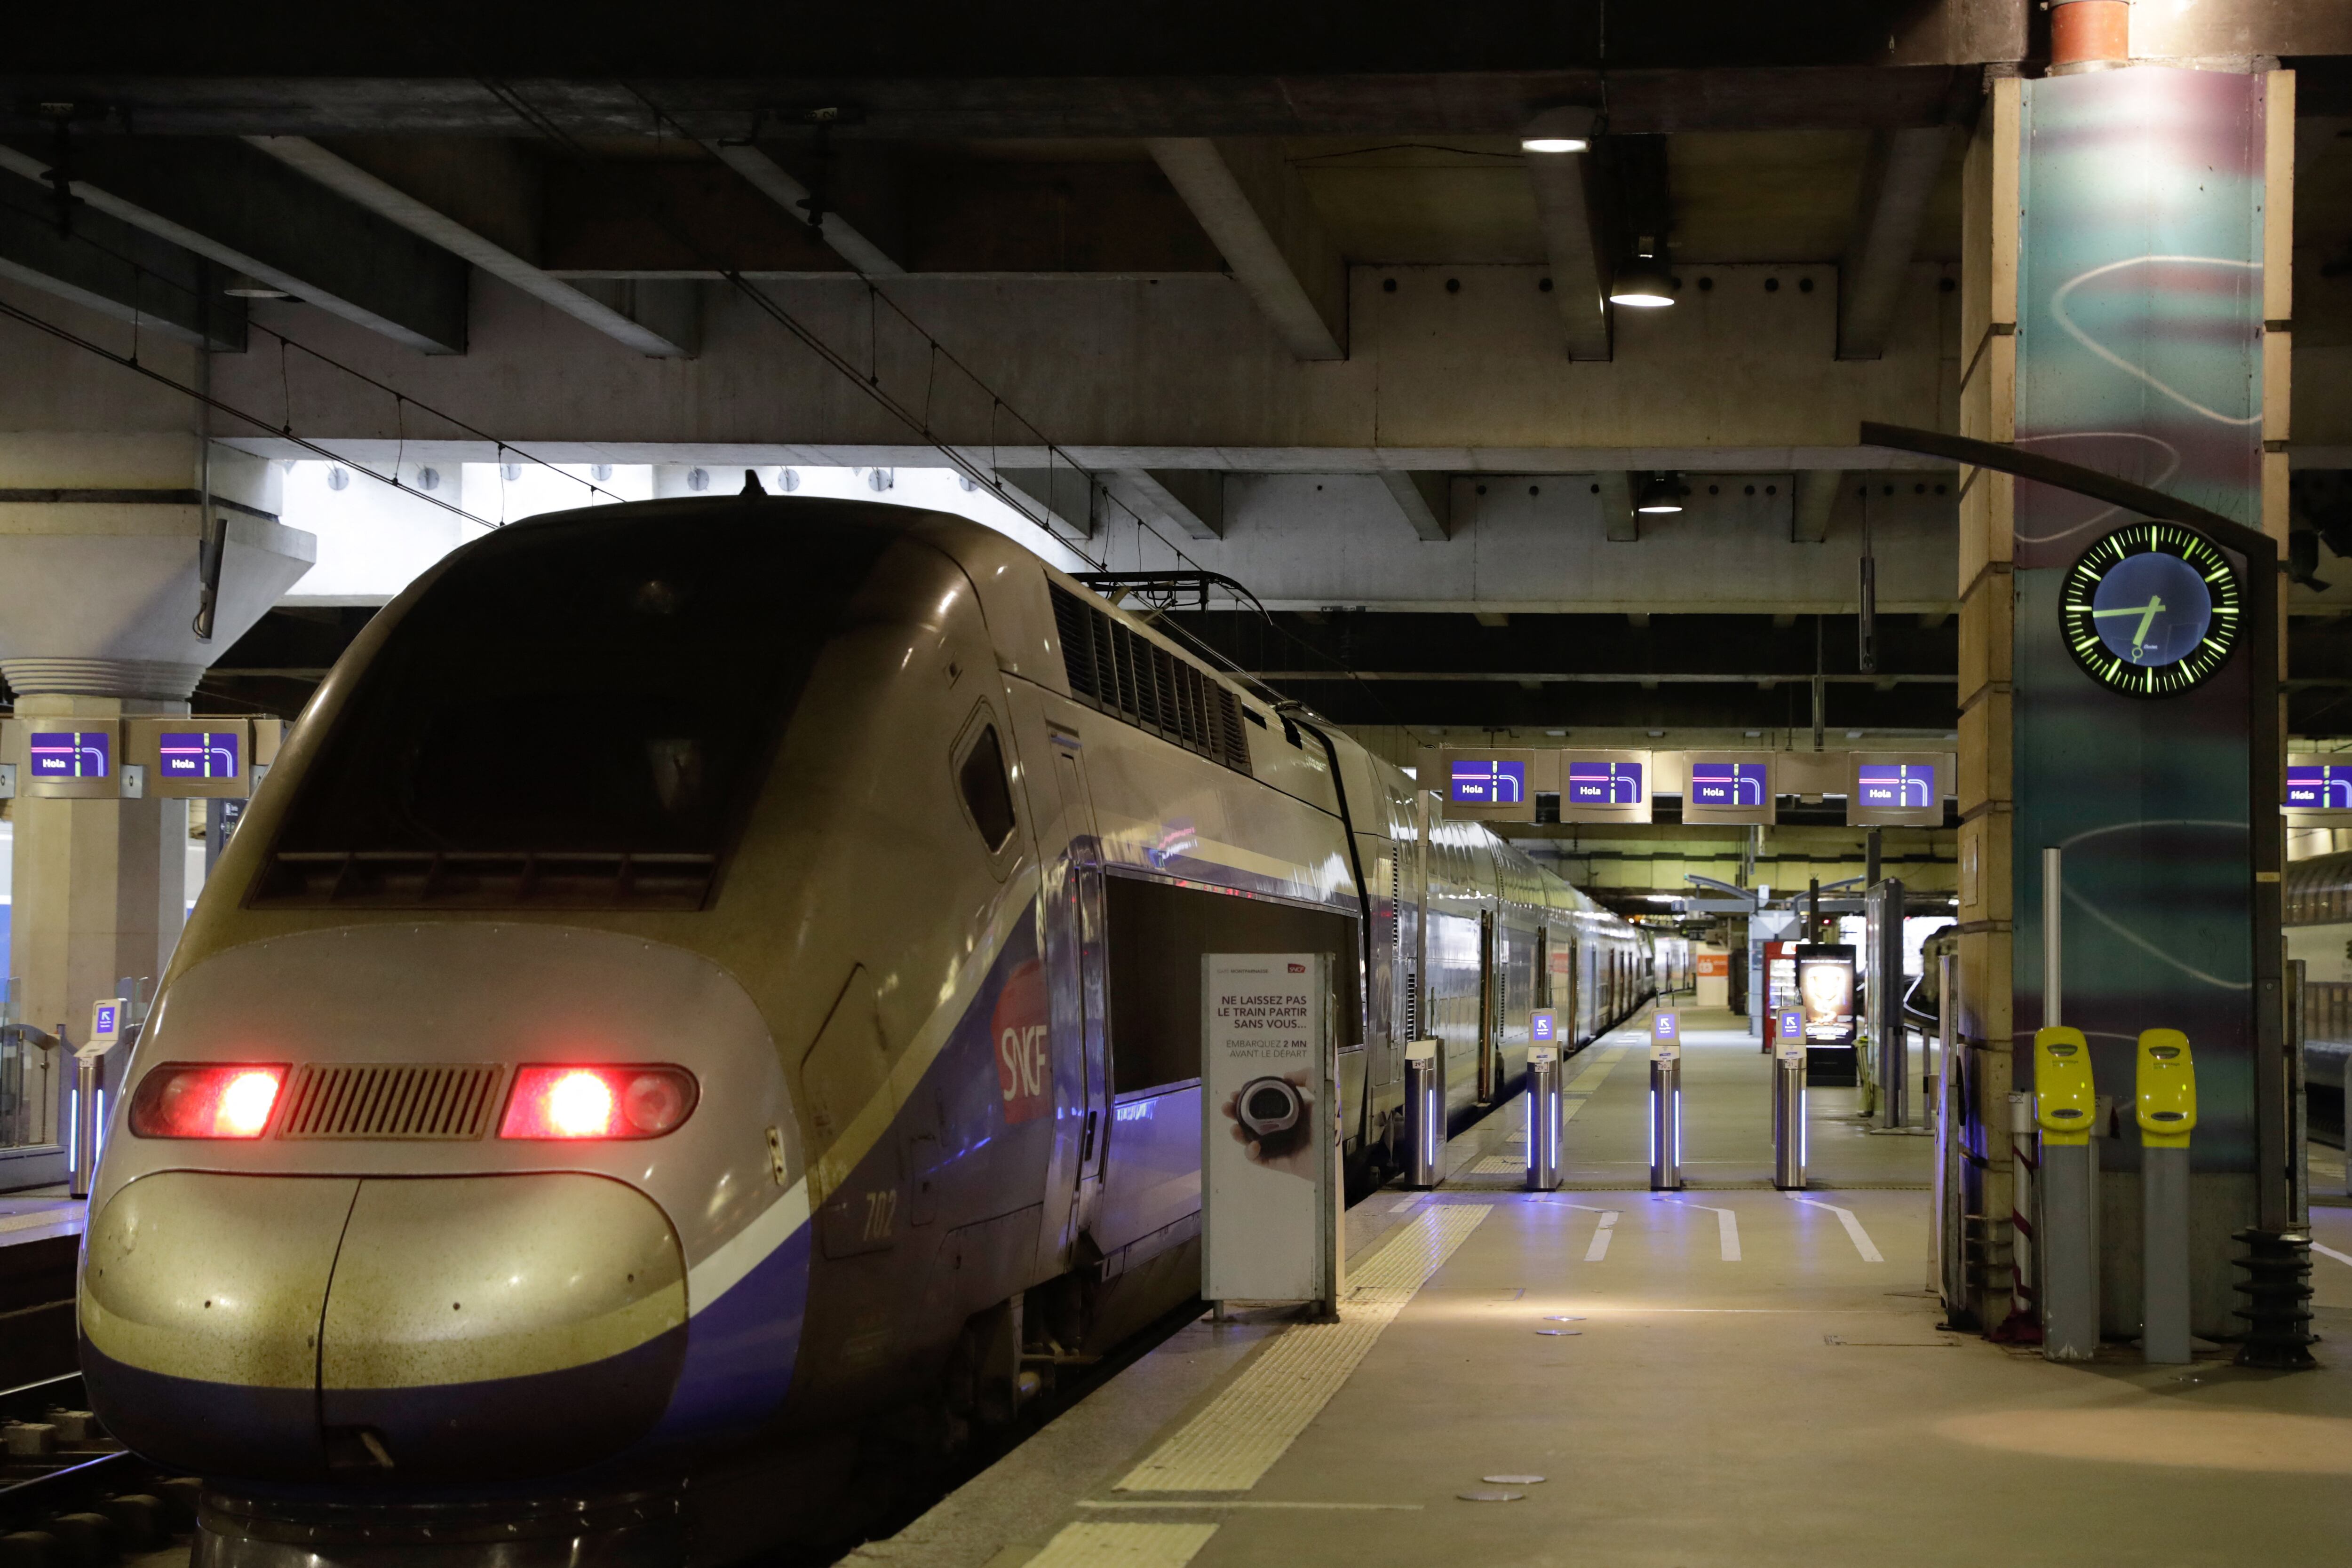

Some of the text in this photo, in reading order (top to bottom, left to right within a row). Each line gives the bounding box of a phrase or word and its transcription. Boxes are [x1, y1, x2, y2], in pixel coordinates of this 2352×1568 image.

[43, 759, 66, 768] Hola
[172, 759, 195, 768] Hola
[1462, 784, 1483, 793] Hola
[1580, 786, 1601, 795] Hola
[1703, 787, 1724, 797] Hola
[1870, 789, 1891, 798] Hola
[2291, 791, 2315, 800] Hola
[1222, 996, 1306, 1005] NE LAISSEZ PAS
[1218, 1008, 1307, 1016] LE TRAIN PARTIR
[1234, 1020, 1306, 1028] SANS VOUS...
[1273, 1049, 1307, 1057] DÉPART
[1001, 1025, 1047, 1101] SNCF
[863, 1189, 897, 1241] 702
